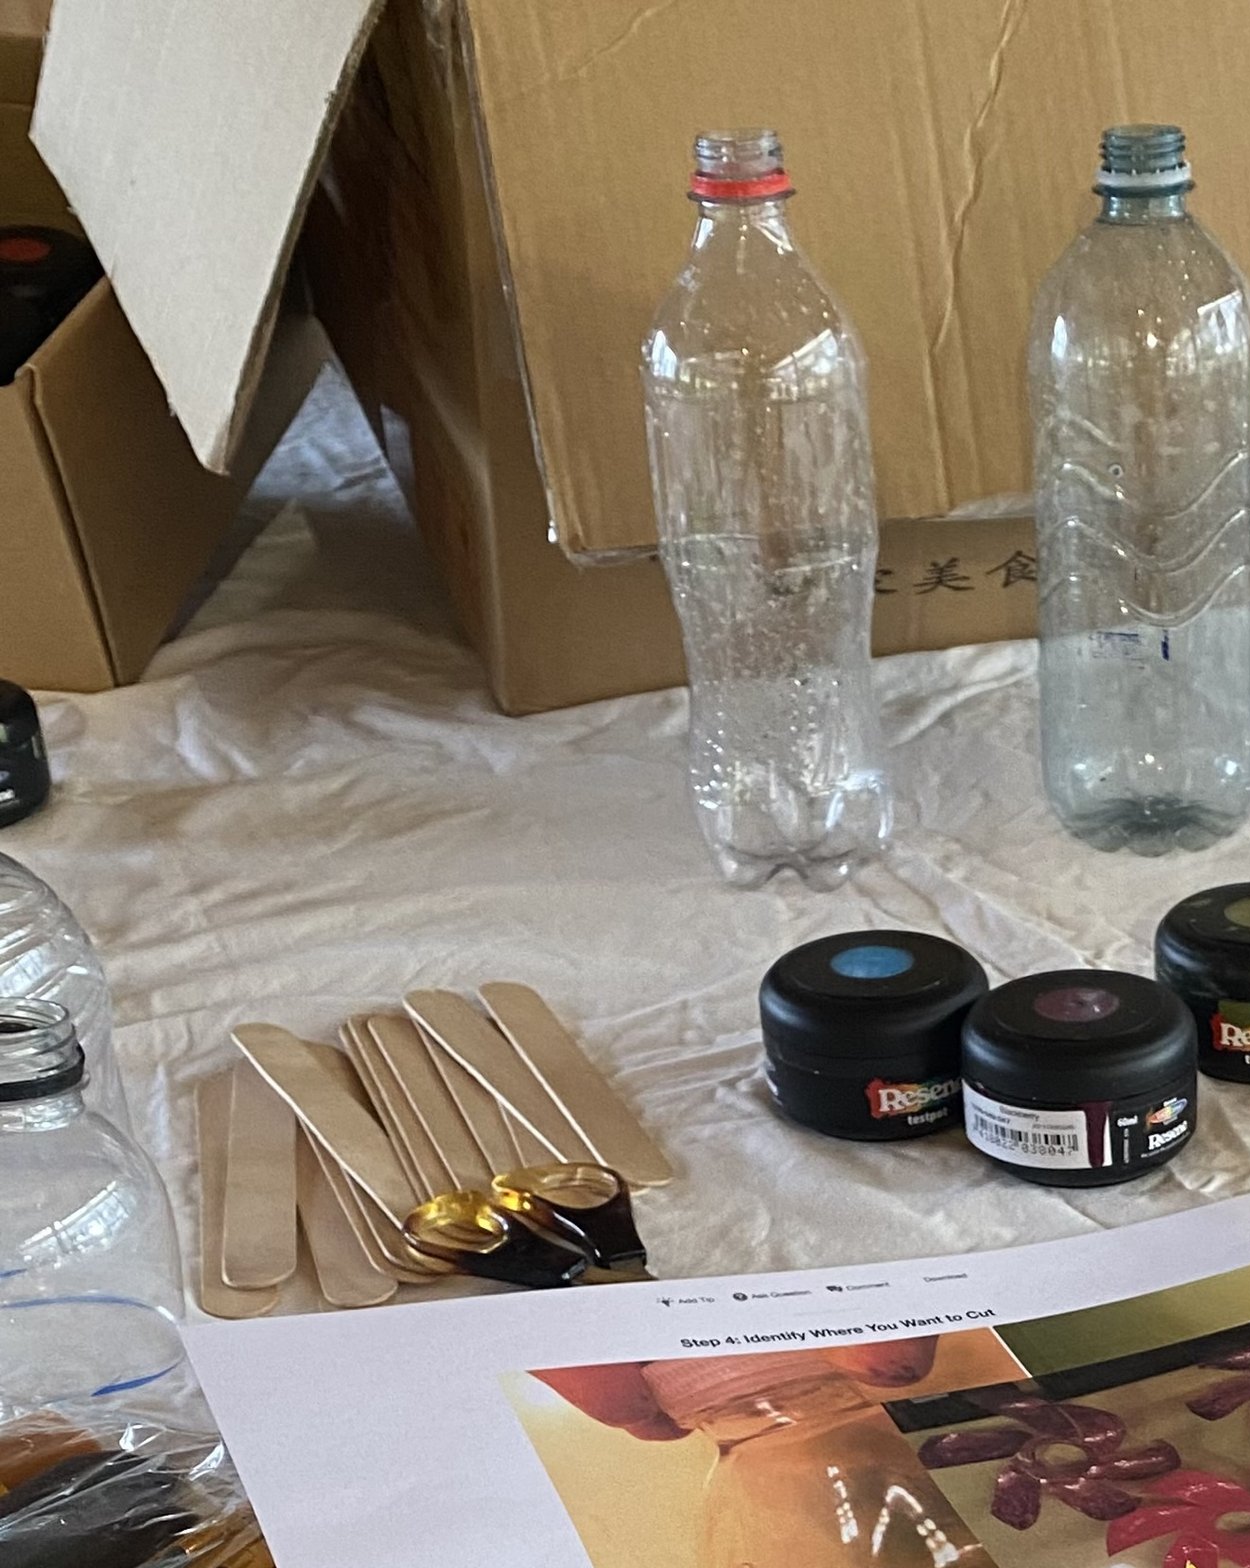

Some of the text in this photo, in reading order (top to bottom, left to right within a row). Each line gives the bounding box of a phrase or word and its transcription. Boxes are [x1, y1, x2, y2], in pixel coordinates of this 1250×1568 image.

[879, 1078, 961, 1112] Resen
[907, 1107, 949, 1126] testpot
[680, 1309, 996, 1348] Step 4: Identify Where You Want to Cut
